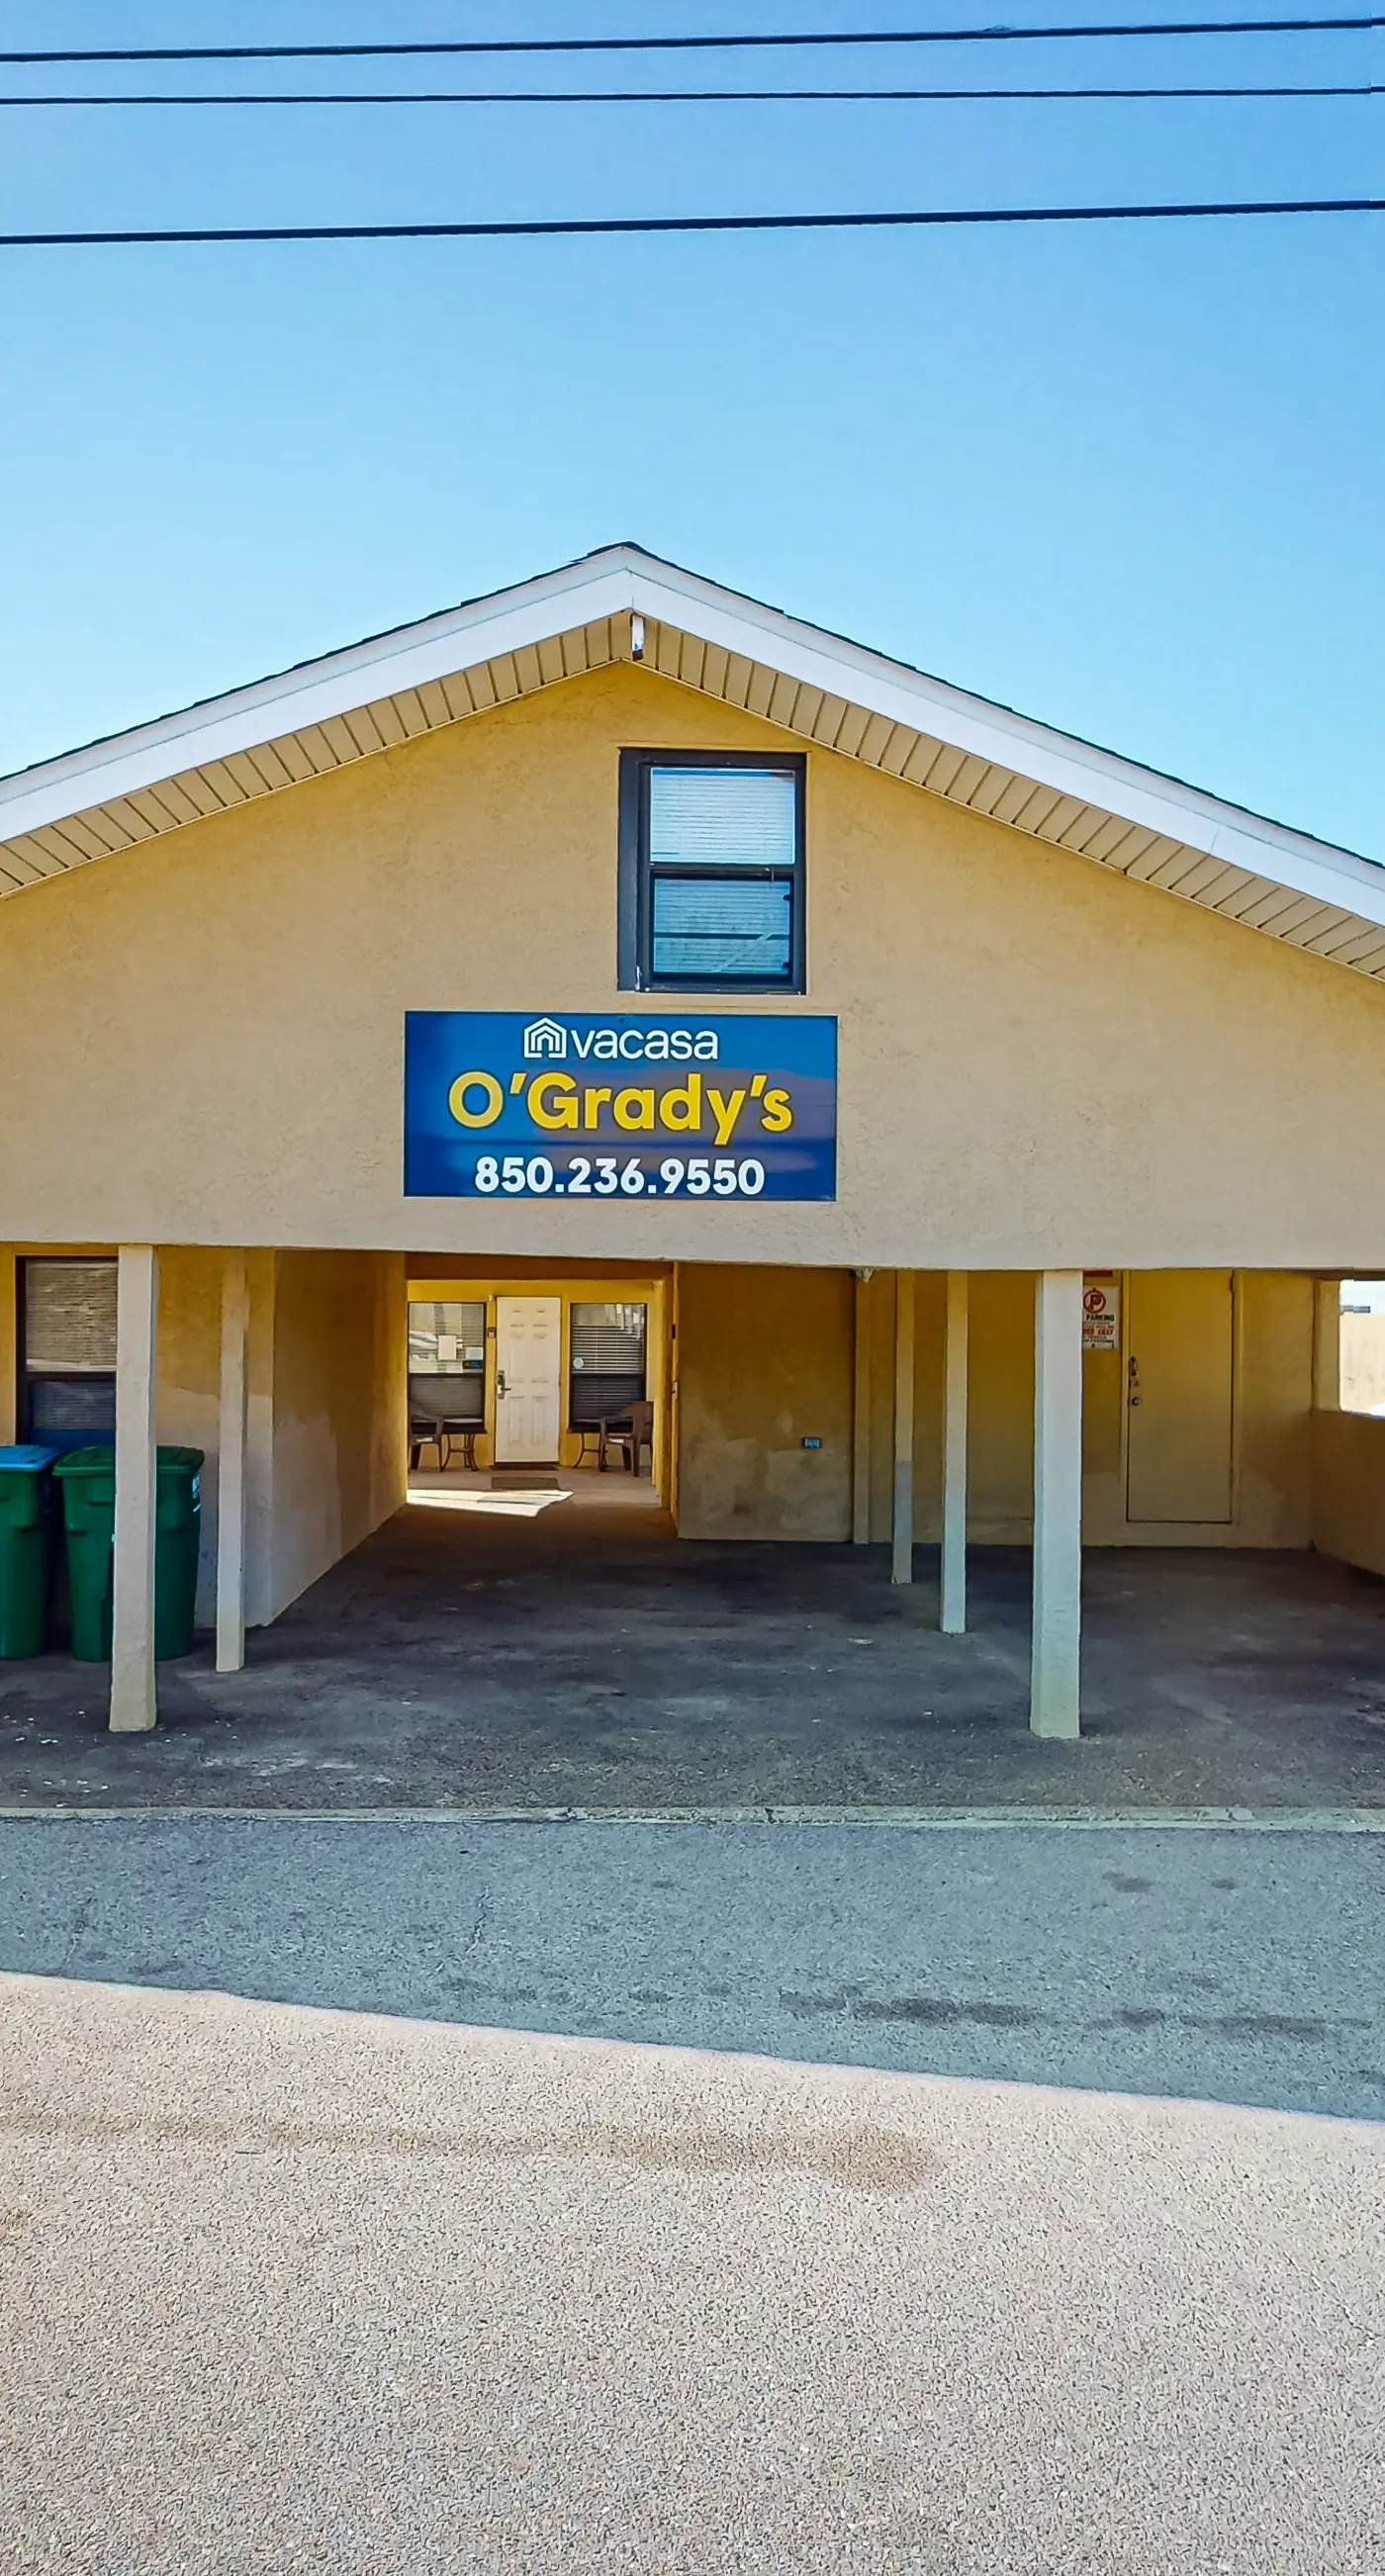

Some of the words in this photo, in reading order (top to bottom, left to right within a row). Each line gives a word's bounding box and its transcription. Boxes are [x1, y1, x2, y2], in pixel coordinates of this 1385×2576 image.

[571, 1029, 719, 1060] vacasa
[448, 1069, 793, 1146] O'Grady's
[474, 1155, 766, 1195] 850.236.9550
